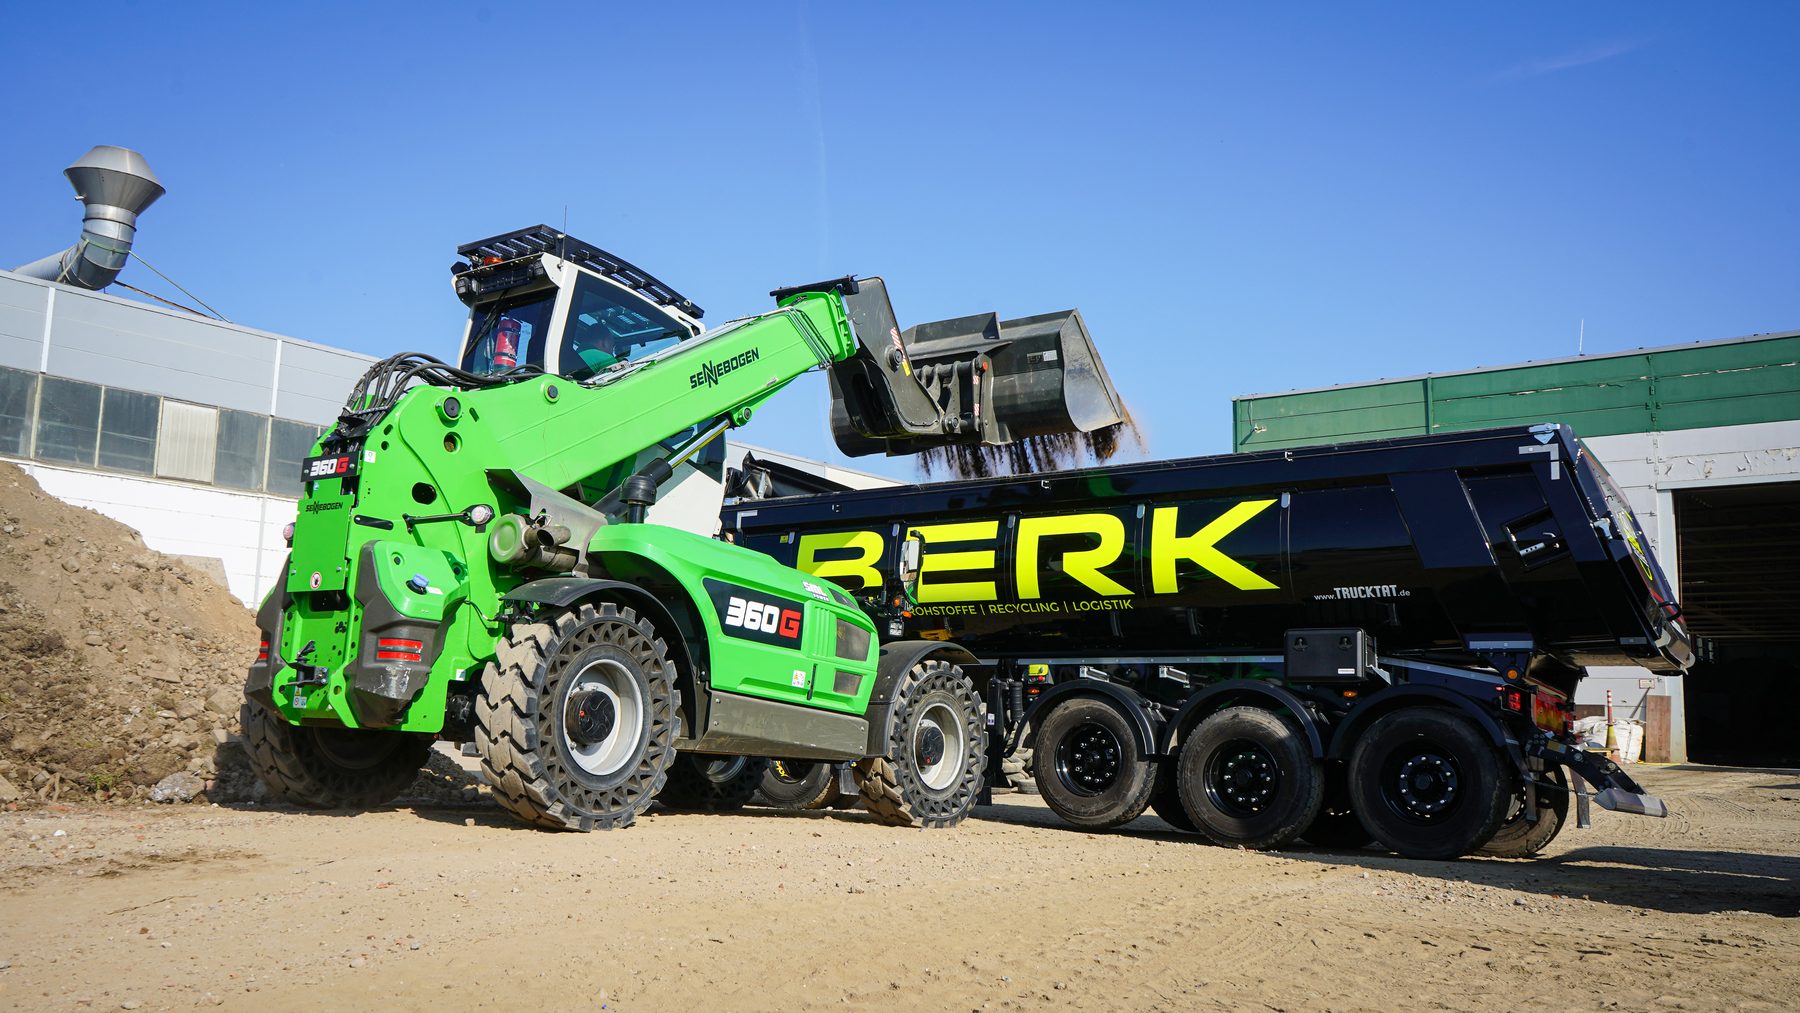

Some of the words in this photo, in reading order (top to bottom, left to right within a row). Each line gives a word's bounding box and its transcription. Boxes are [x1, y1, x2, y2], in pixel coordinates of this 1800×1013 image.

[690, 347, 759, 389] SENNEBOGEN
[310, 456, 350, 477] 360G
[305, 501, 344, 515] SENNEBOGEN
[797, 499, 1280, 603] BERK
[1313, 584, 1411, 601] www.TRUCKTAT.de
[988, 602, 1060, 614] RECYCLING
[1073, 599, 1134, 612] LOGISTIK
[725, 596, 802, 639] 360G
